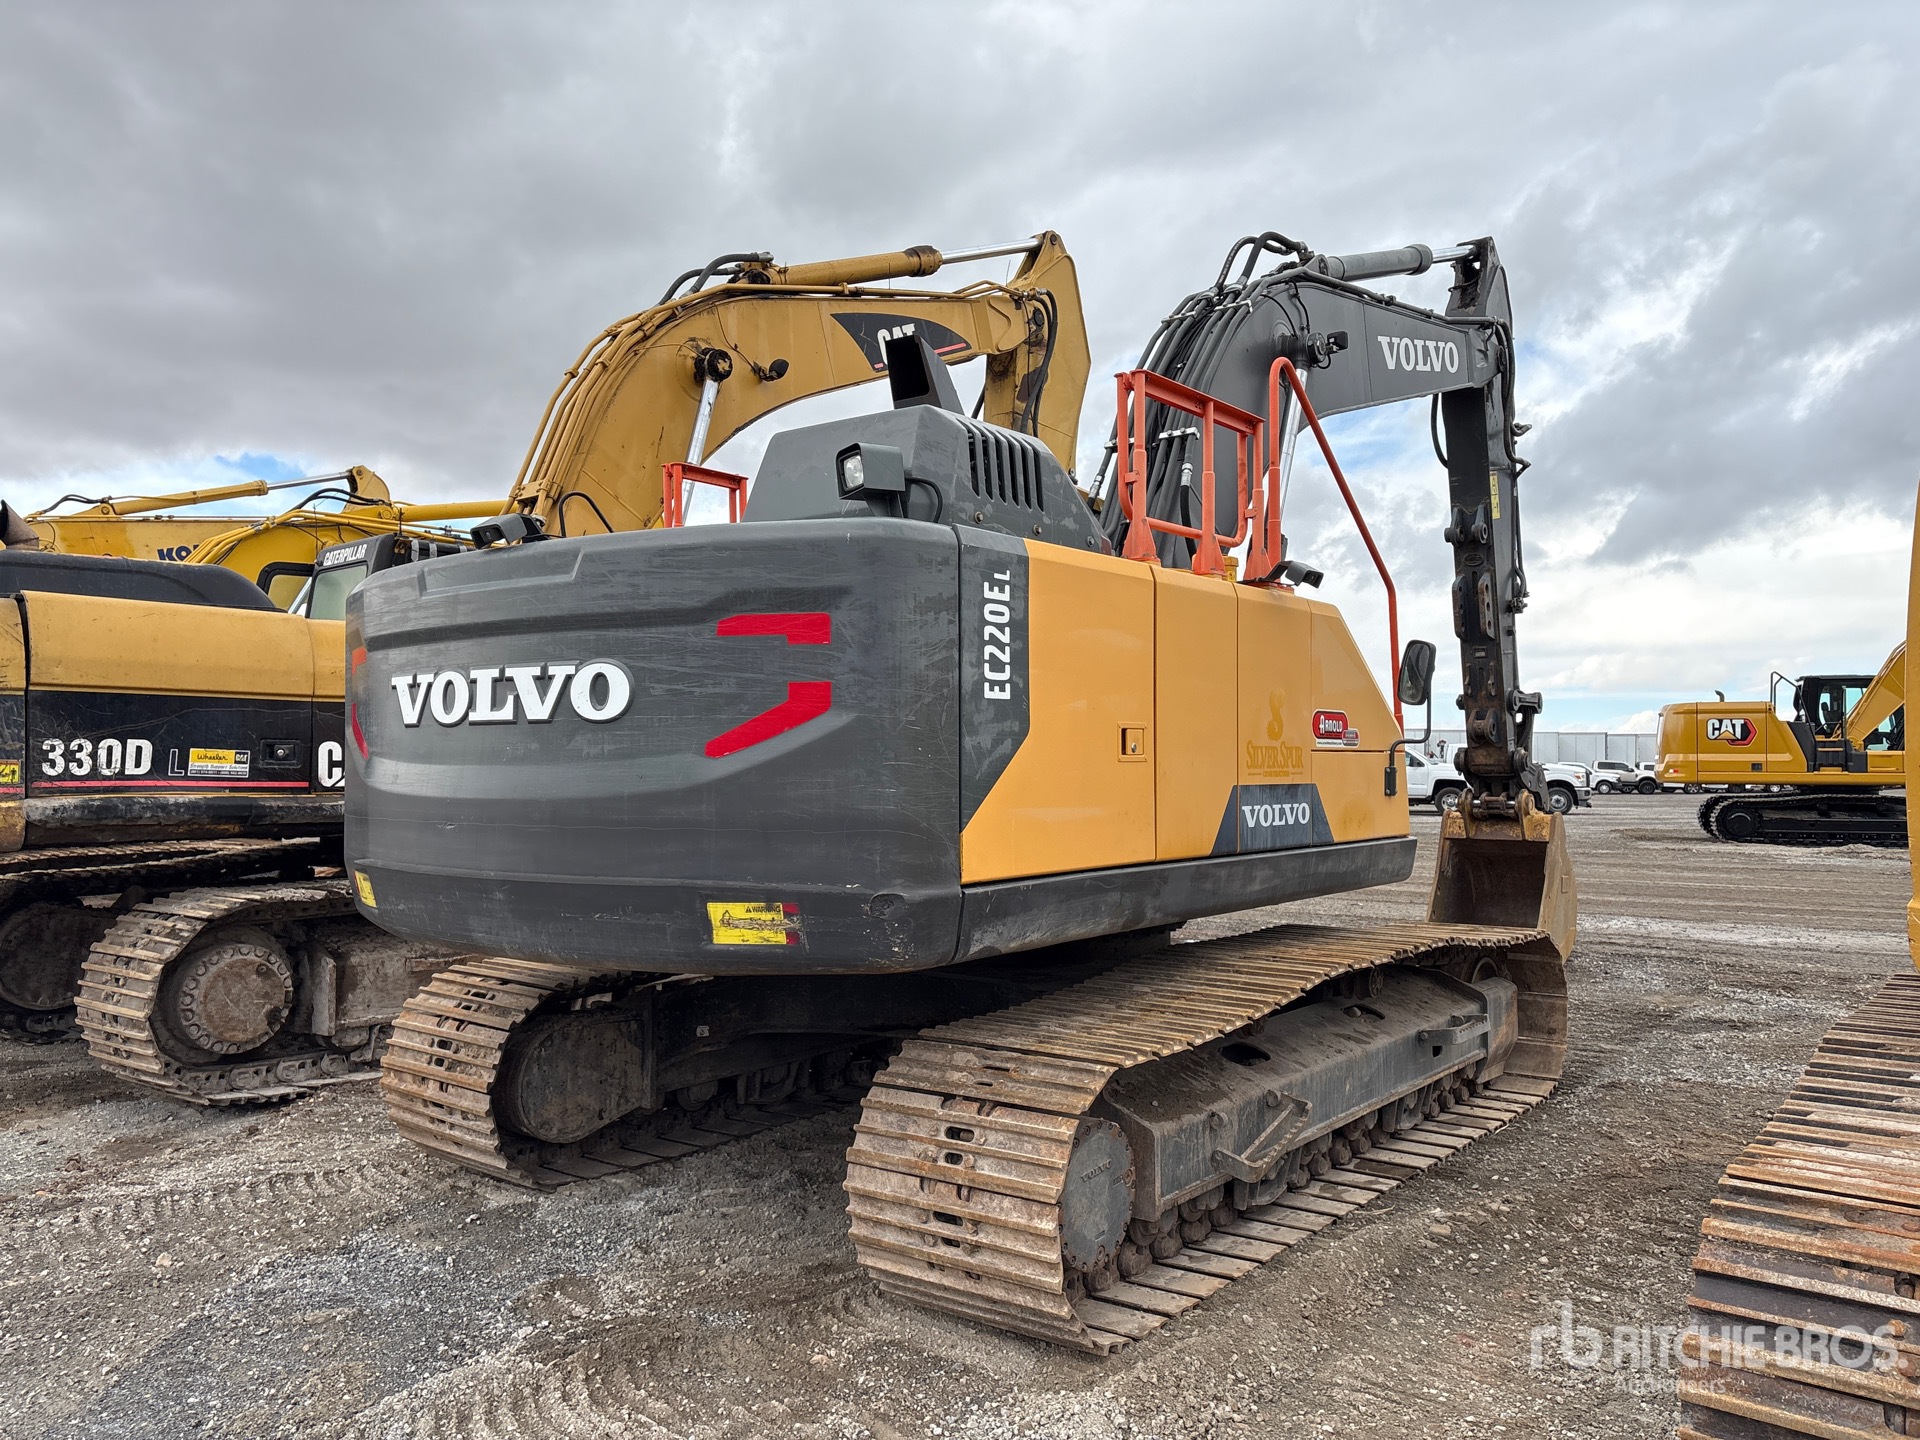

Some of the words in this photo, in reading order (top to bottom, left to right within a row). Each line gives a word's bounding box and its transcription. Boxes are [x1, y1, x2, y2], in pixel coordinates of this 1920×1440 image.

[1377, 335, 1459, 373] VOLVO
[157, 544, 199, 562] KO
[323, 544, 367, 566] CATERPILLAR
[391, 659, 632, 727] VOLVO
[1707, 718, 1745, 740] CAT
[41, 738, 153, 776] 330D
[1242, 802, 1310, 828] VOLVO
